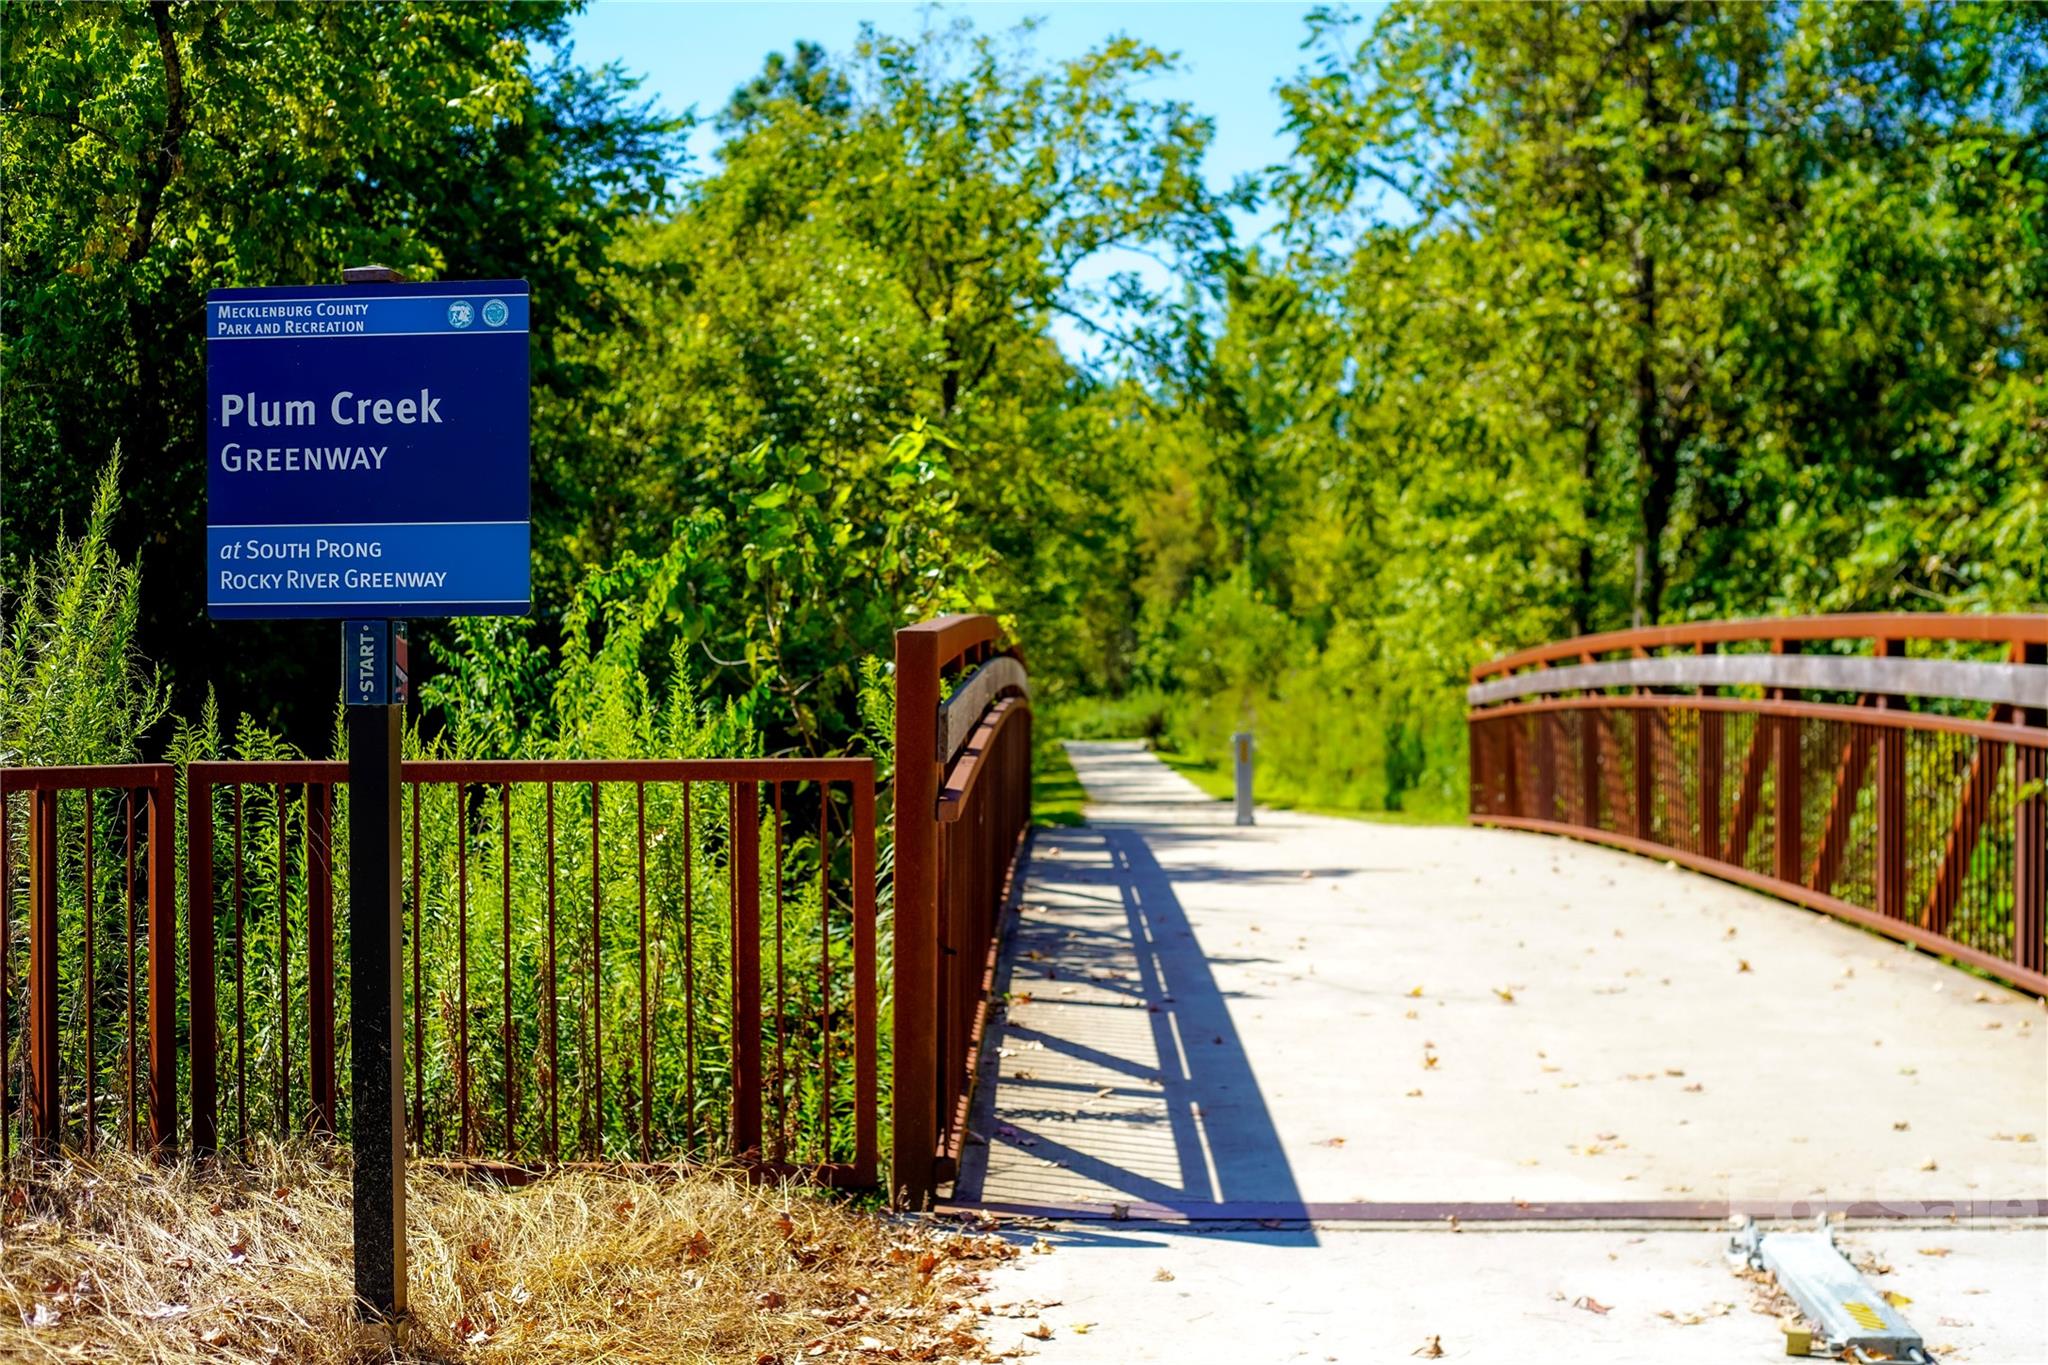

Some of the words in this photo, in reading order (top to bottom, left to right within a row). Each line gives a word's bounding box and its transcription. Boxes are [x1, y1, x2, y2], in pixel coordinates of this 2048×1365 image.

[218, 305, 312, 319] MECKLENBURG
[317, 303, 369, 316] COUNTY
[218, 322, 252, 335] PARK
[255, 323, 281, 335] AND
[285, 320, 364, 334] RECREATION
[221, 391, 316, 427] Plum
[331, 388, 443, 425] Creek
[221, 443, 388, 472] GREENWAY
[220, 541, 242, 560] at
[246, 539, 310, 559] SOUTH
[316, 539, 382, 558] PRONG
[221, 570, 283, 589] ROCKY
[287, 569, 340, 589] RIVER
[344, 569, 447, 588] GREENWAY
[359, 633, 374, 693] START
